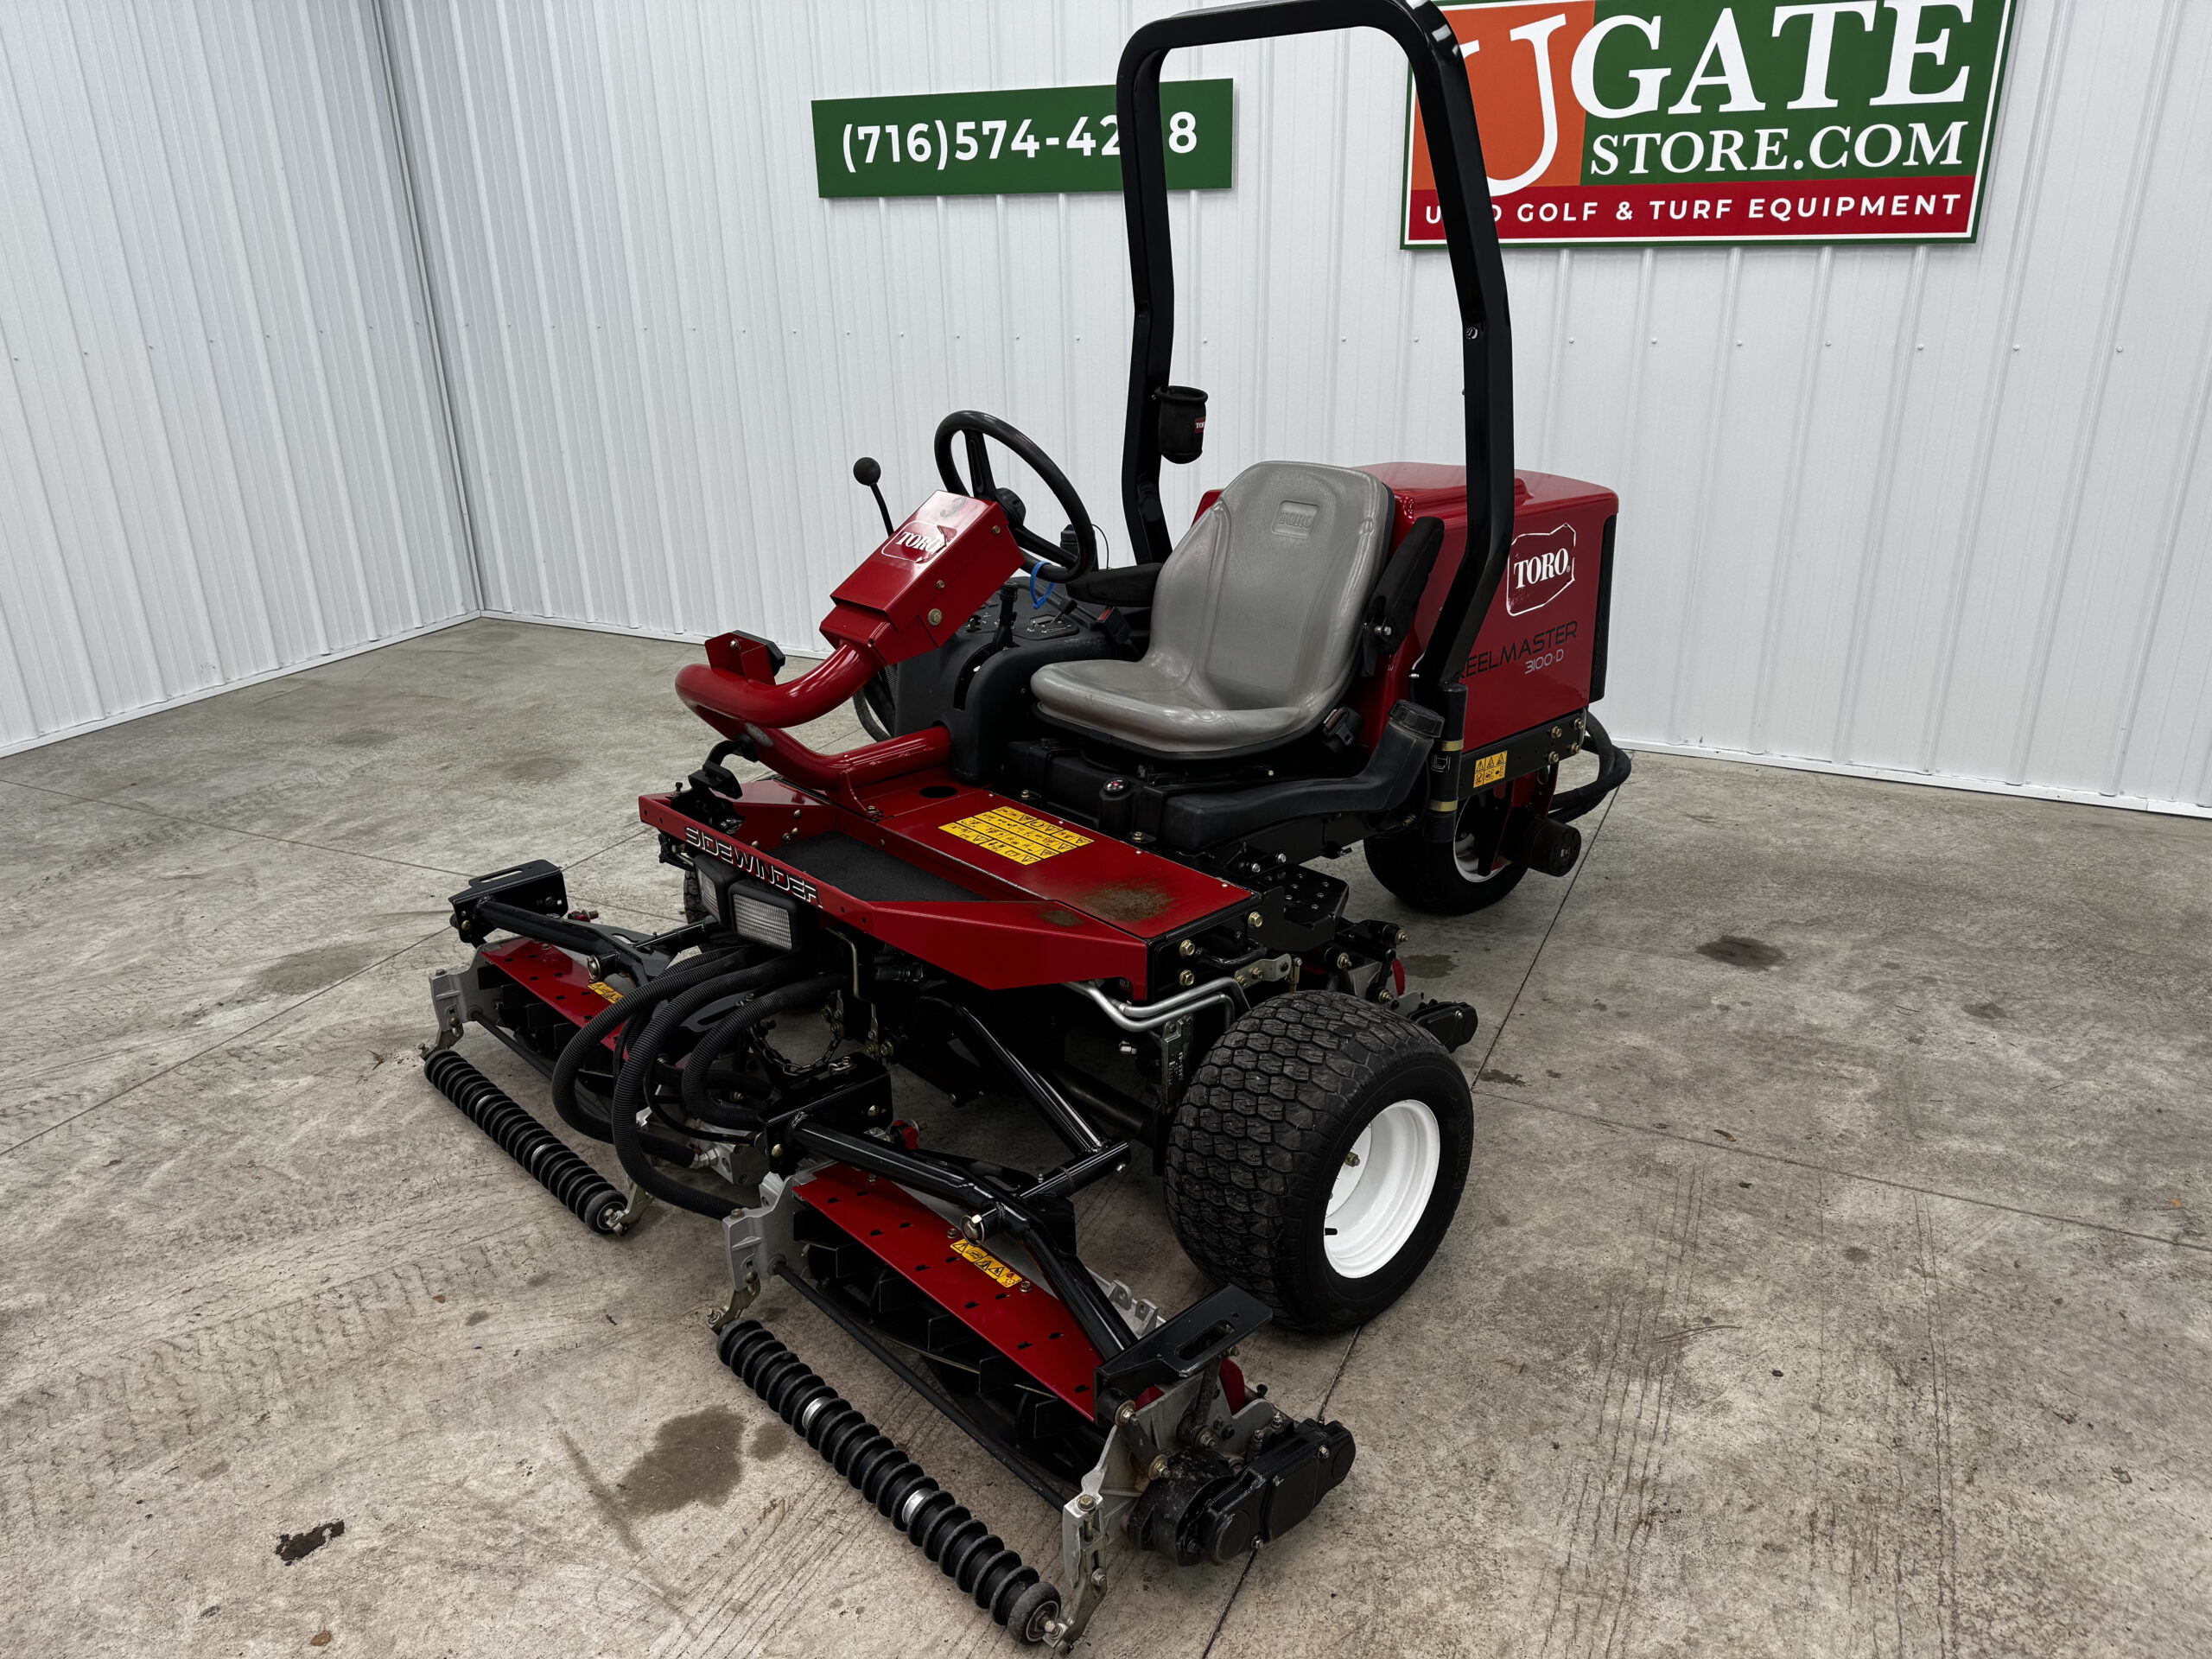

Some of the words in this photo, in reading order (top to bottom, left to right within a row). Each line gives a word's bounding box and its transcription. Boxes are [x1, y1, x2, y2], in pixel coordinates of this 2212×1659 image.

[842, 111, 1198, 172] (716)574-428
[1591, 121, 1969, 175] STORE.COM
[1426, 204, 1502, 224] UD
[1517, 201, 1599, 222] GOLF
[1616, 202, 1633, 221] &
[1649, 200, 1732, 219] TURF
[1748, 194, 1961, 222] EQUIPMENT
[1514, 548, 1568, 589] TORO
[1459, 620, 1578, 678] EELMASTER
[685, 826, 823, 909] SIDEWINDER
